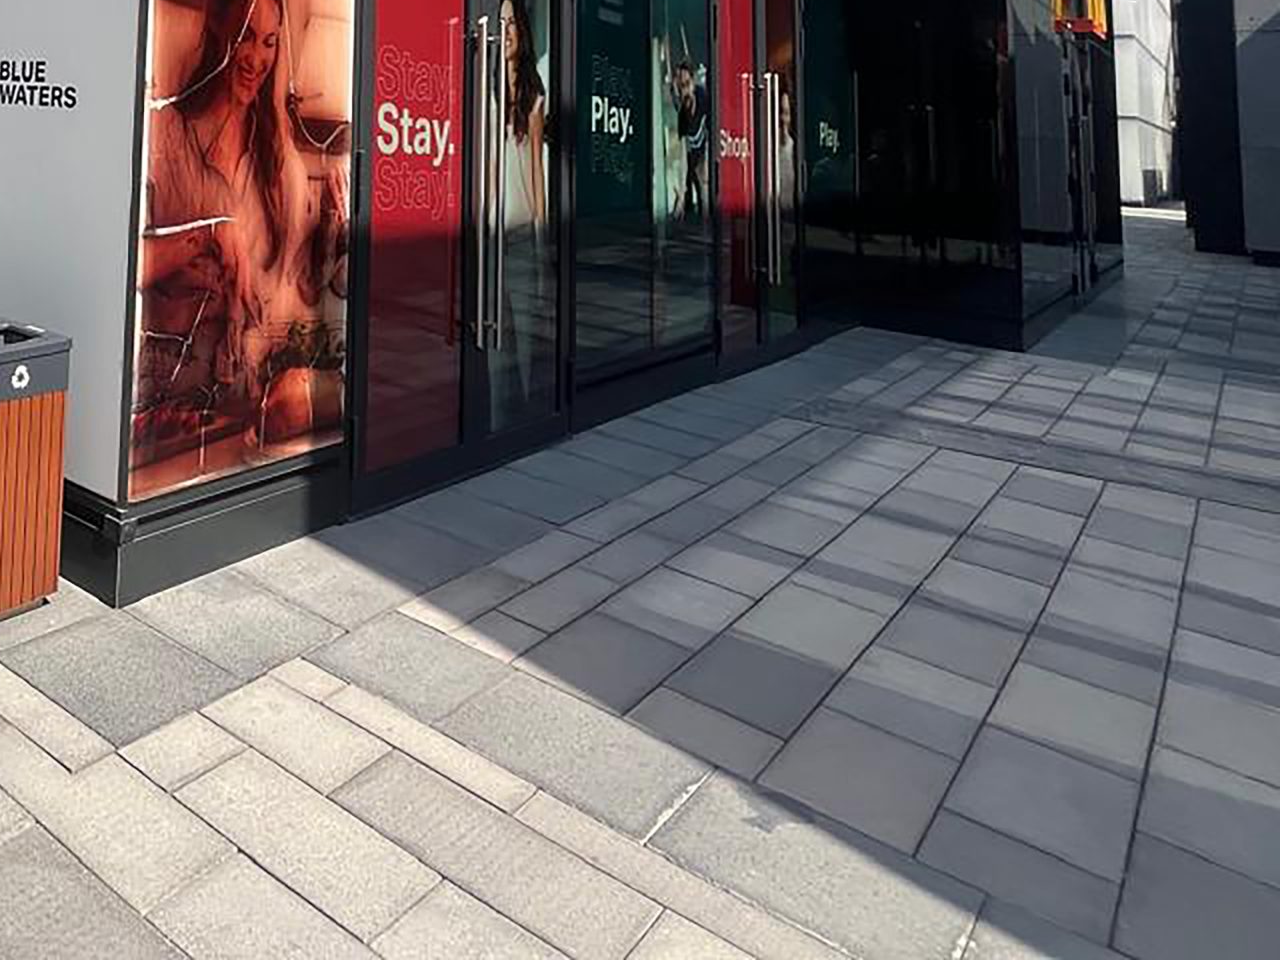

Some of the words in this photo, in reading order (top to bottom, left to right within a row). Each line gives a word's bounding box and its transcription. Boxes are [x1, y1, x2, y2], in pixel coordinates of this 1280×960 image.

[0, 61, 46, 82] BLUE
[0, 84, 77, 108] WATERS
[377, 102, 454, 167] Stay.
[591, 96, 634, 143] Play.
